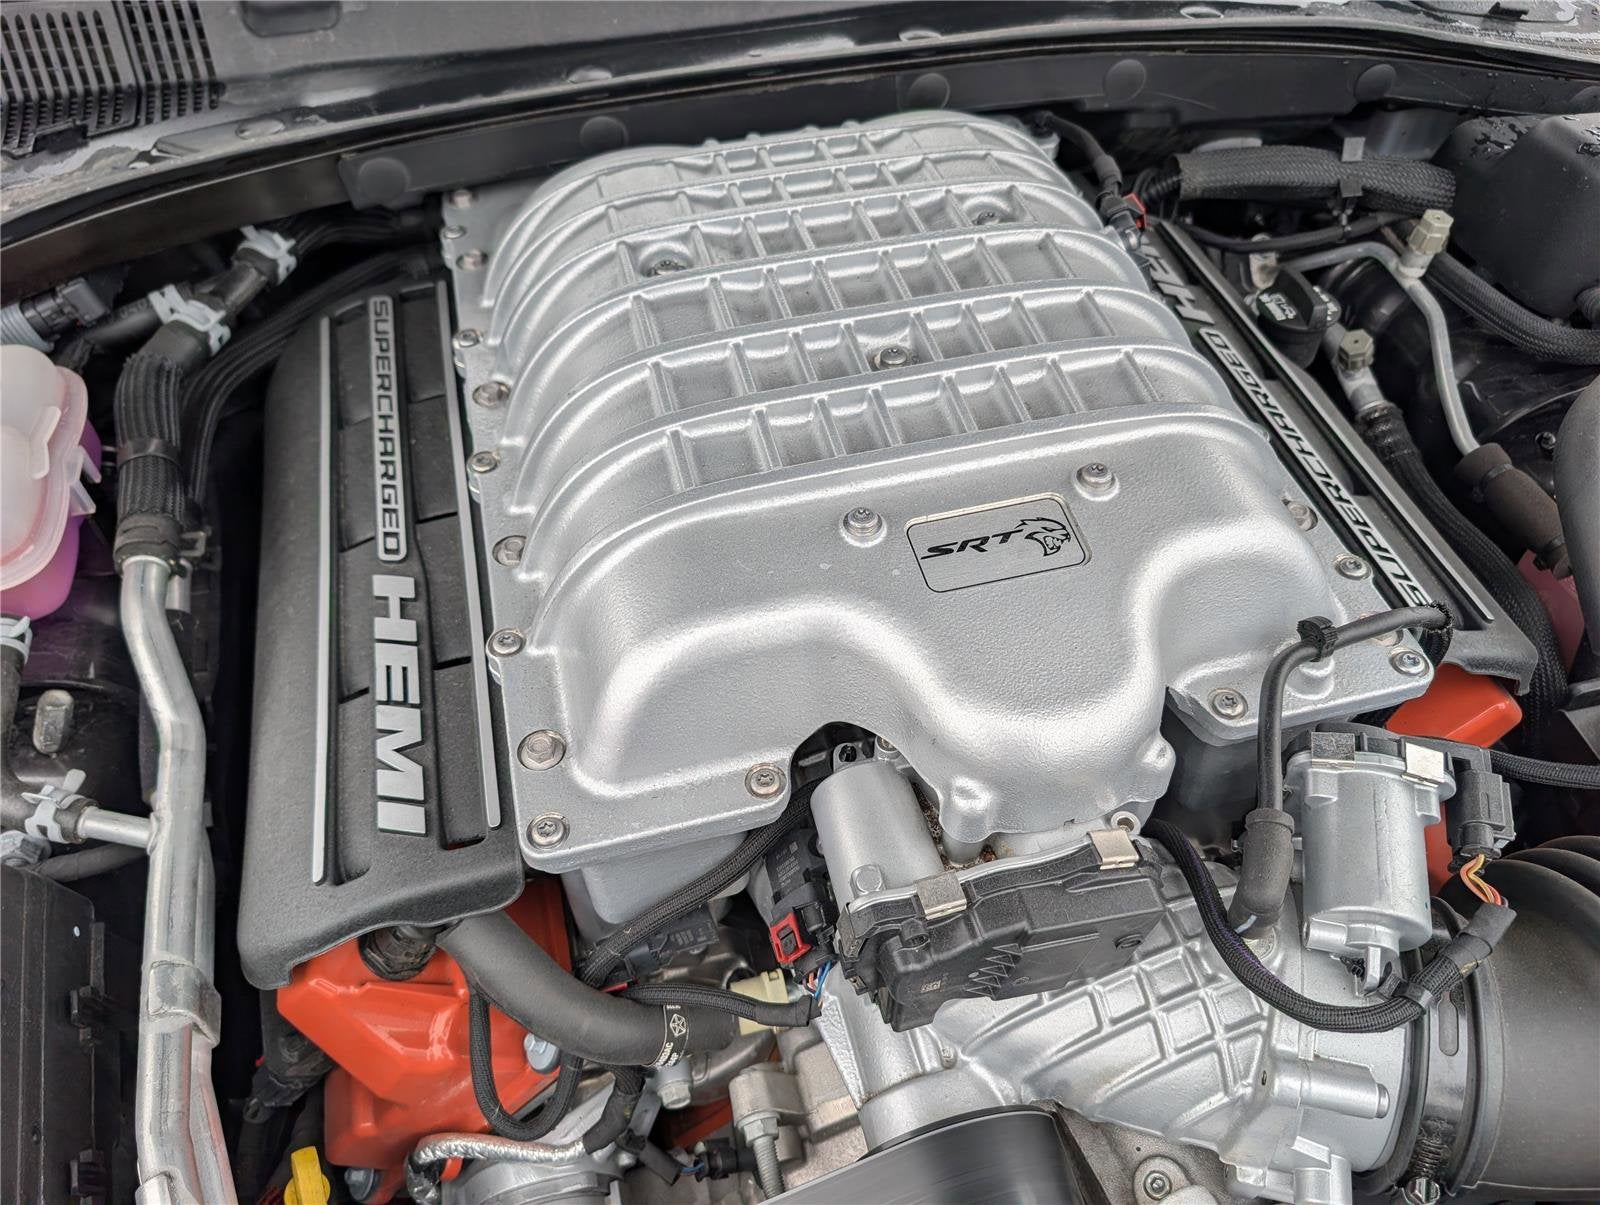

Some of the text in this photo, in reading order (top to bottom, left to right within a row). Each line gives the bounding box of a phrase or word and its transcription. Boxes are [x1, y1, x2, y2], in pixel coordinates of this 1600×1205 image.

[372, 299, 426, 834] SUPERCHARGED HEMI
[920, 528, 1024, 560] SRT
[1139, 238, 1430, 607] SUPERCHARGED HE
